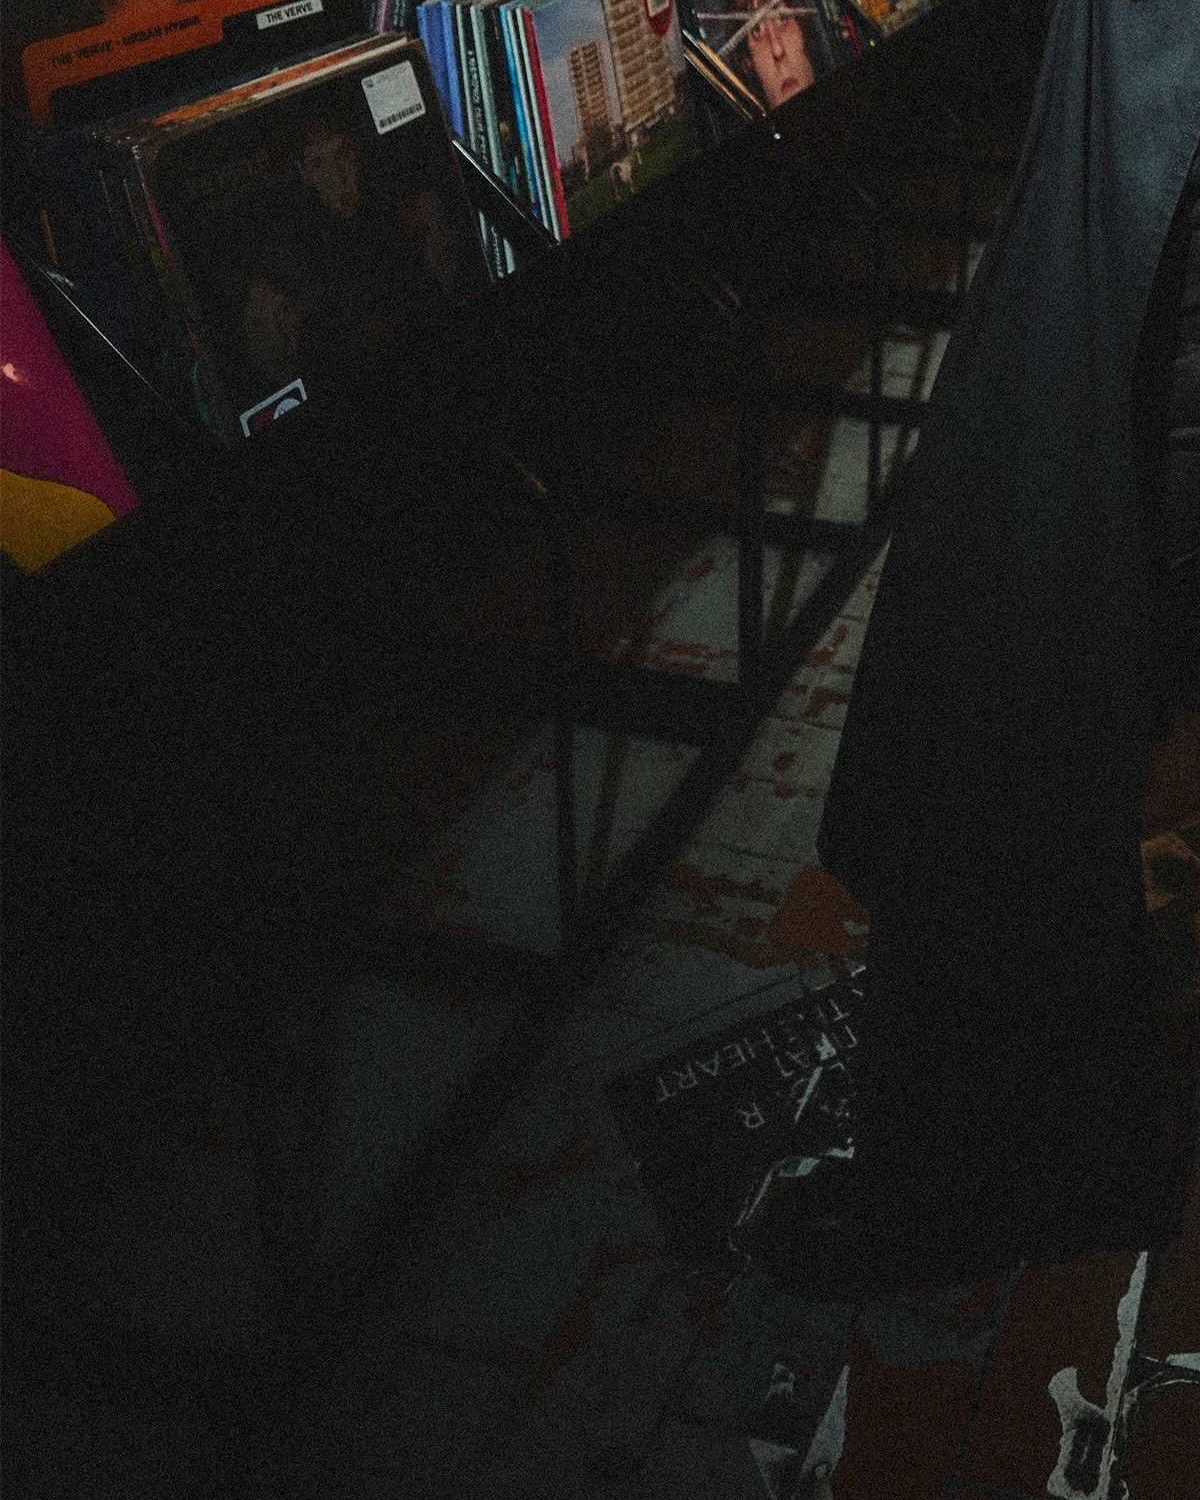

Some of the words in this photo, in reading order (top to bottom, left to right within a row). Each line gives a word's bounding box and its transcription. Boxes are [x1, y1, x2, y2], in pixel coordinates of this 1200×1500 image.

[265, 10, 283, 24] THE
[284, 2, 313, 20] VERVE
[77, 39, 113, 60] VERVE
[657, 1029, 776, 1102] HEART
